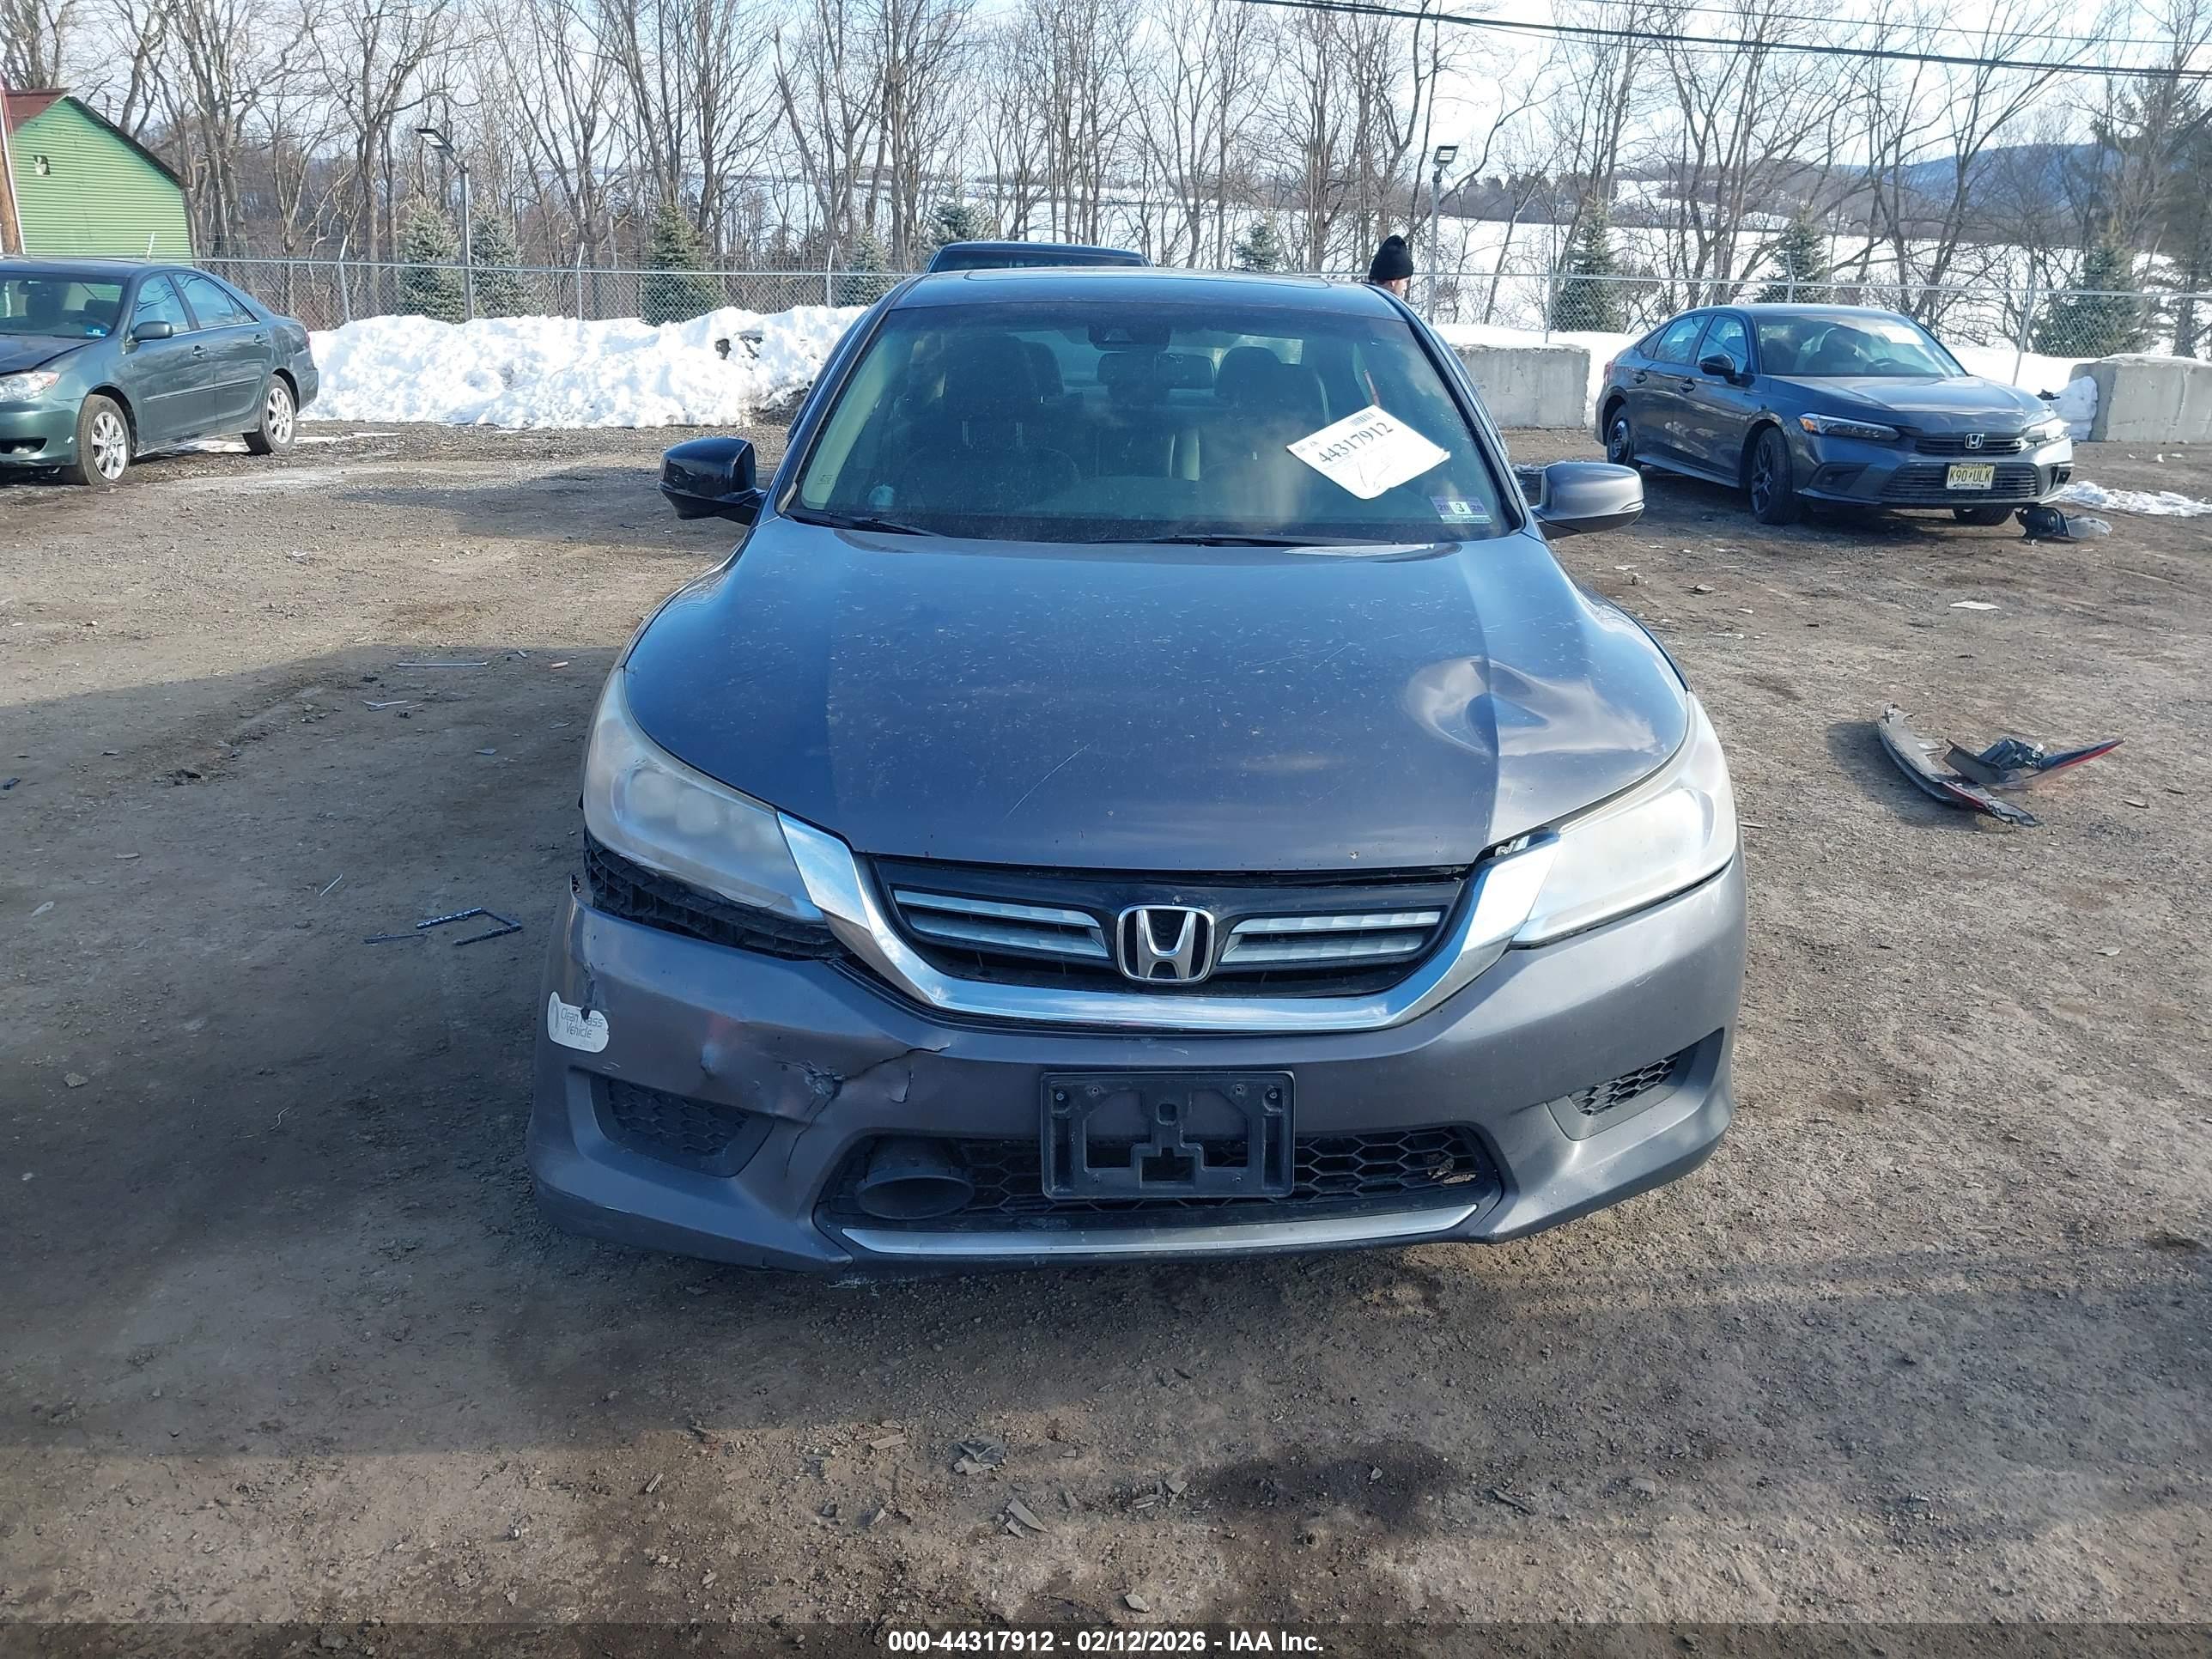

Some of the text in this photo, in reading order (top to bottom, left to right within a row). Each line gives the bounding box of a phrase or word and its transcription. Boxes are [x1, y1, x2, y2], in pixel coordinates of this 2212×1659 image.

[1318, 422, 1394, 463] 44317912
[1455, 502, 1465, 513] 3
[567, 1021, 592, 1039] Vehicle
